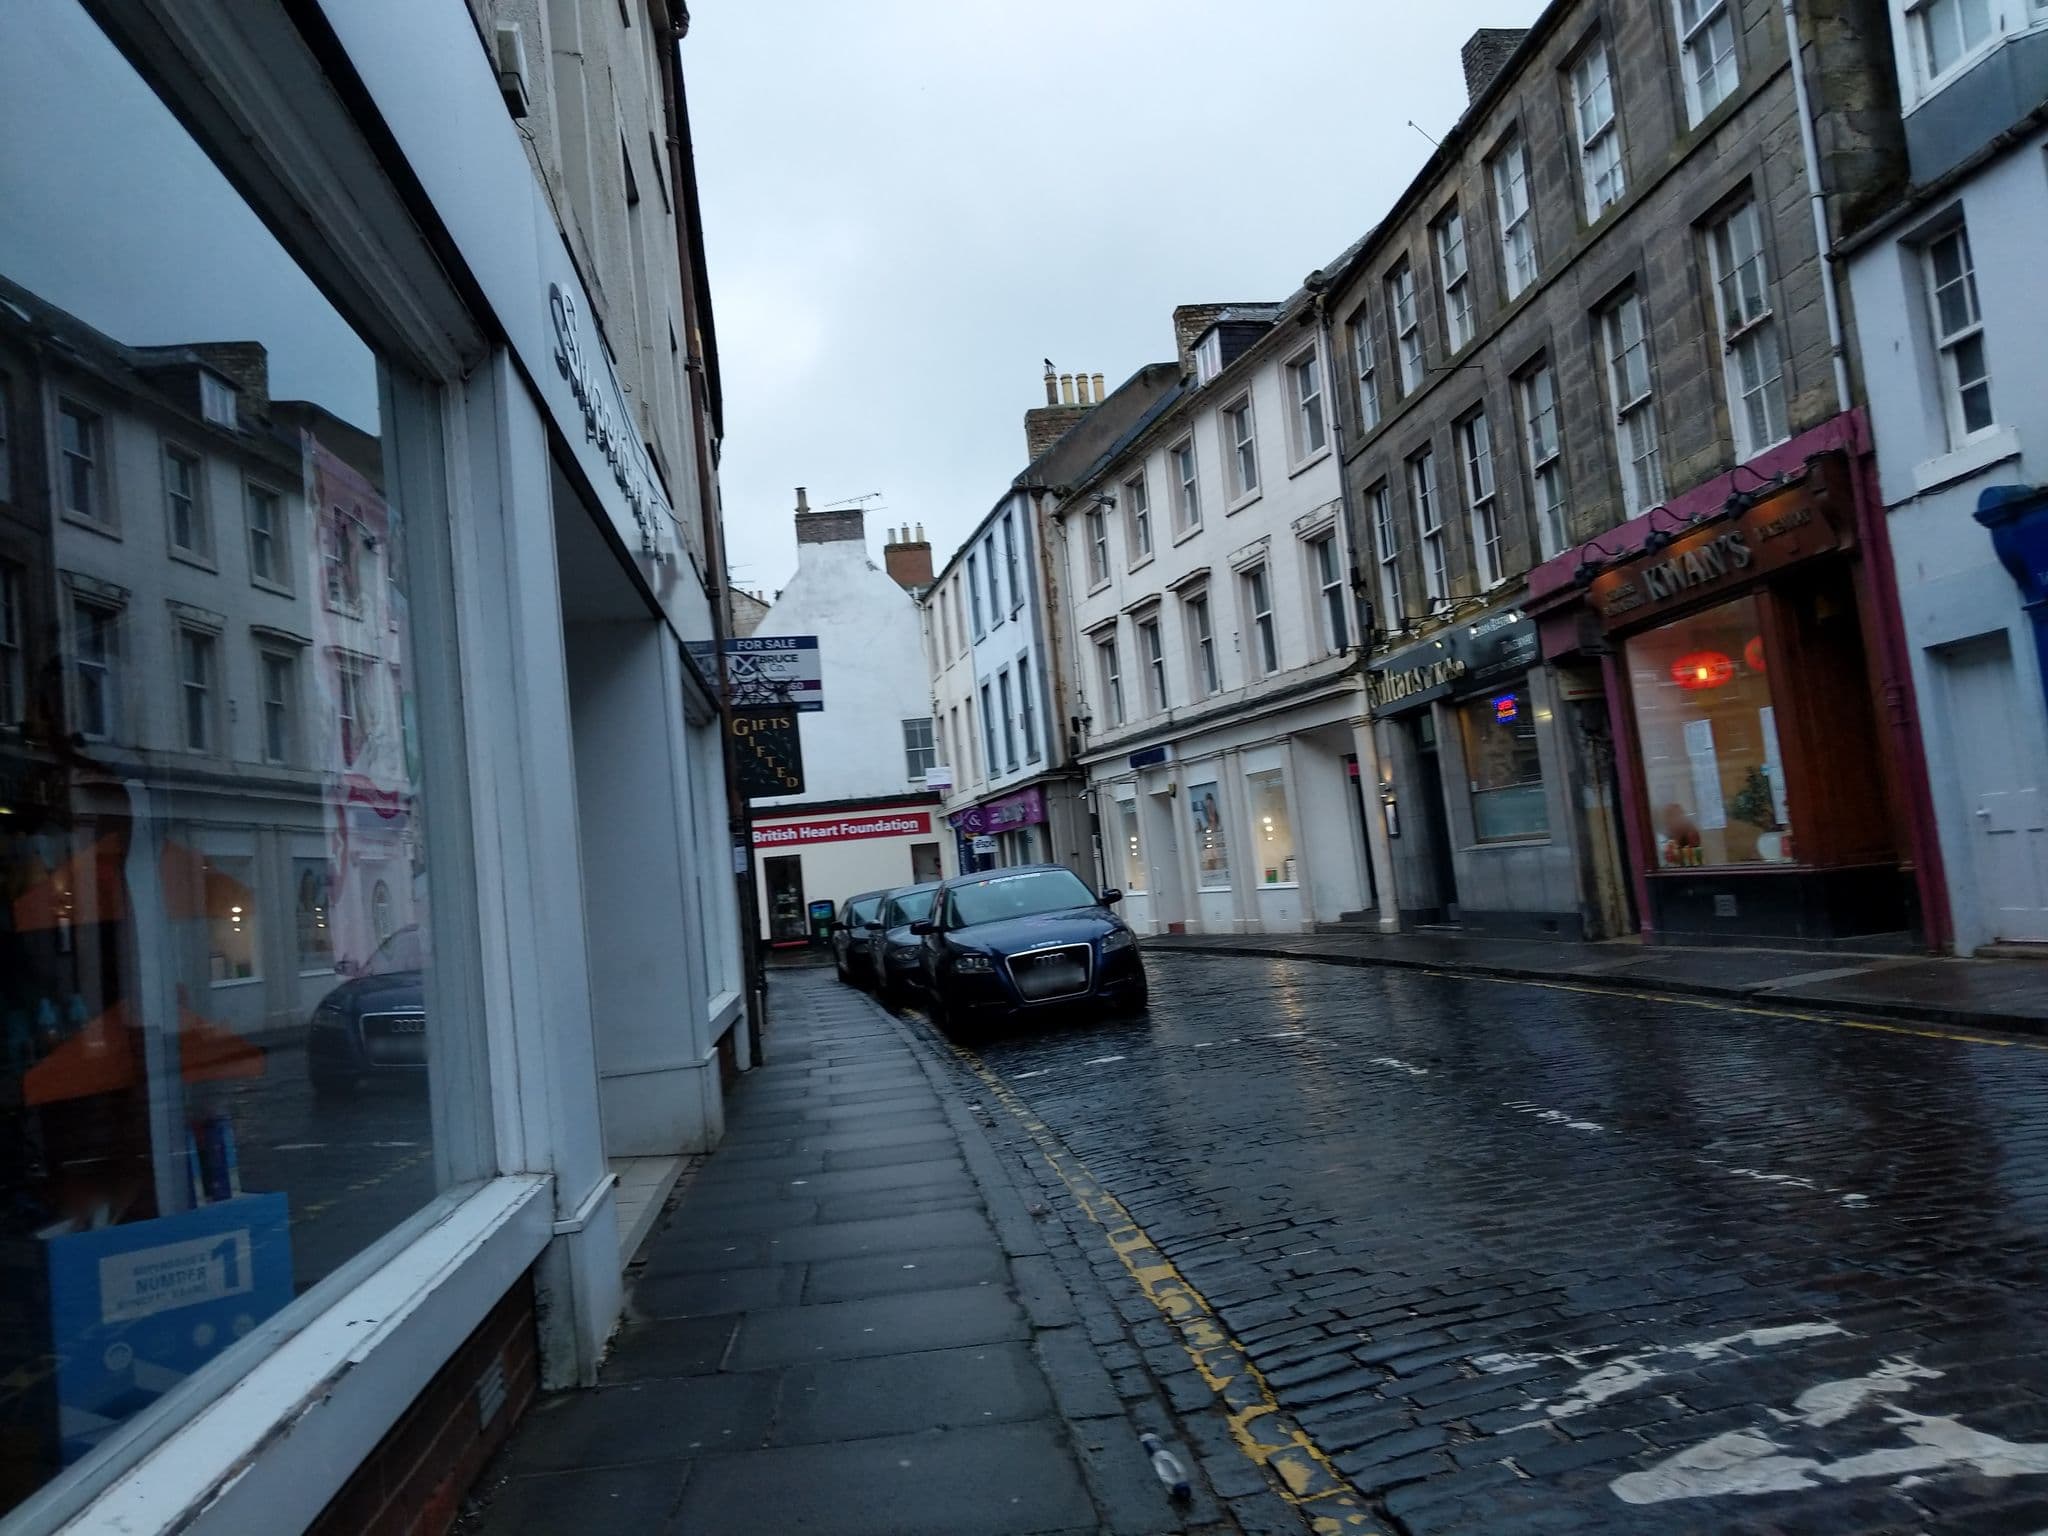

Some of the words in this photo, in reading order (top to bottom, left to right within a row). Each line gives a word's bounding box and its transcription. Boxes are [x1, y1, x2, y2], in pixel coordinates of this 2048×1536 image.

[1641, 531, 1750, 600] KWAN'S
[736, 640, 762, 650] FOR
[764, 639, 797, 649] SALE
[760, 654, 799, 663] BRUCE
[732, 718, 790, 736] GIFTS
[753, 828, 797, 843] British
[800, 825, 838, 839] Heart
[840, 819, 918, 834] Foundation
[211, 1238, 241, 1289] 1
